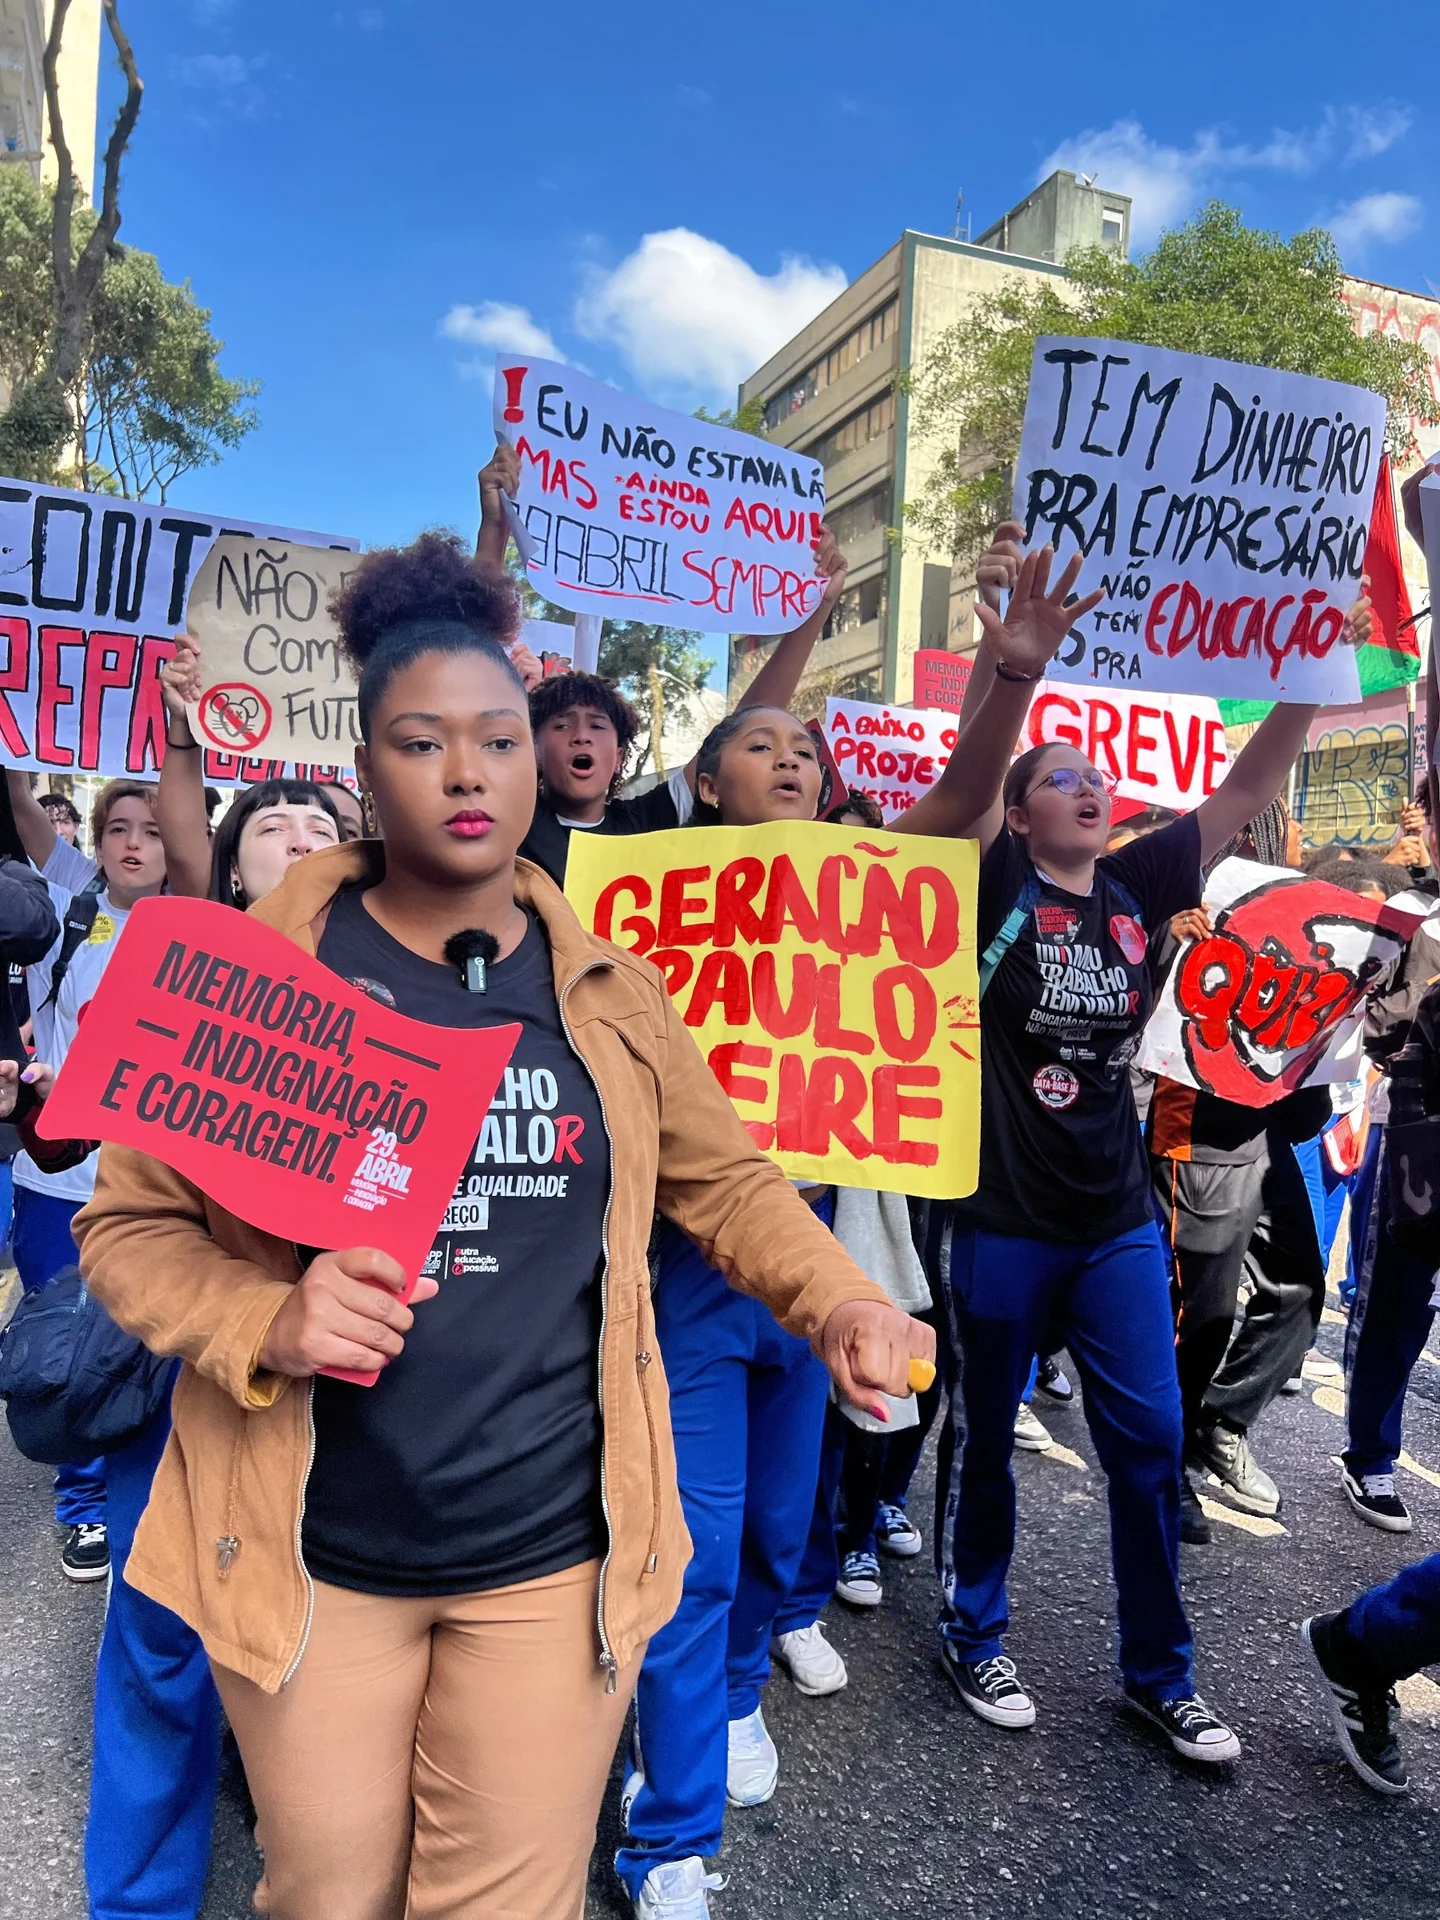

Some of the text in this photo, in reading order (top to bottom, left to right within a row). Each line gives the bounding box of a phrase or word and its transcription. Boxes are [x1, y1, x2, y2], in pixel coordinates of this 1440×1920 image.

[1044, 349, 1182, 470] TEM
[538, 384, 588, 441] EU
[601, 423, 675, 469] NÃO
[687, 446, 788, 489] ESTAVA
[791, 468, 825, 507] LÁ
[516, 436, 598, 510] MAS
[619, 494, 821, 550] ESTOU AQUI!
[1022, 468, 1117, 558] PRA
[554, 515, 685, 601] ABRIL
[217, 549, 318, 622] NÃO
[1100, 560, 1151, 601] NÃO
[1094, 608, 1142, 635] TEM
[1144, 580, 1343, 681] EDUCAÇÃO
[1092, 646, 1142, 680] PRA
[925, 689, 931, 701] E
[832, 711, 850, 734] A
[833, 736, 949, 786] PROJE
[1028, 693, 1226, 796] GREVE
[593, 842, 960, 968] GERAÇÃO
[1038, 961, 1128, 996] TRABALHO
[1040, 982, 1140, 1016] TEM VALOR
[152, 940, 358, 1067] MEMÓRIA,
[1029, 1008, 1077, 1029] EDUCAÇÃO
[1025, 1021, 1046, 1035] NÃO
[181, 1020, 428, 1145] INDIGNAÇÃO
[1033, 1078, 1069, 1092] DATA-BASE
[99, 1058, 343, 1184] E CORAGEM.
[365, 1127, 397, 1158] 29
[354, 1153, 413, 1193] ABRIL
[467, 1175, 569, 1198] QUALIDADE
[454, 1255, 497, 1265] educação
[463, 1264, 499, 1274] possível
